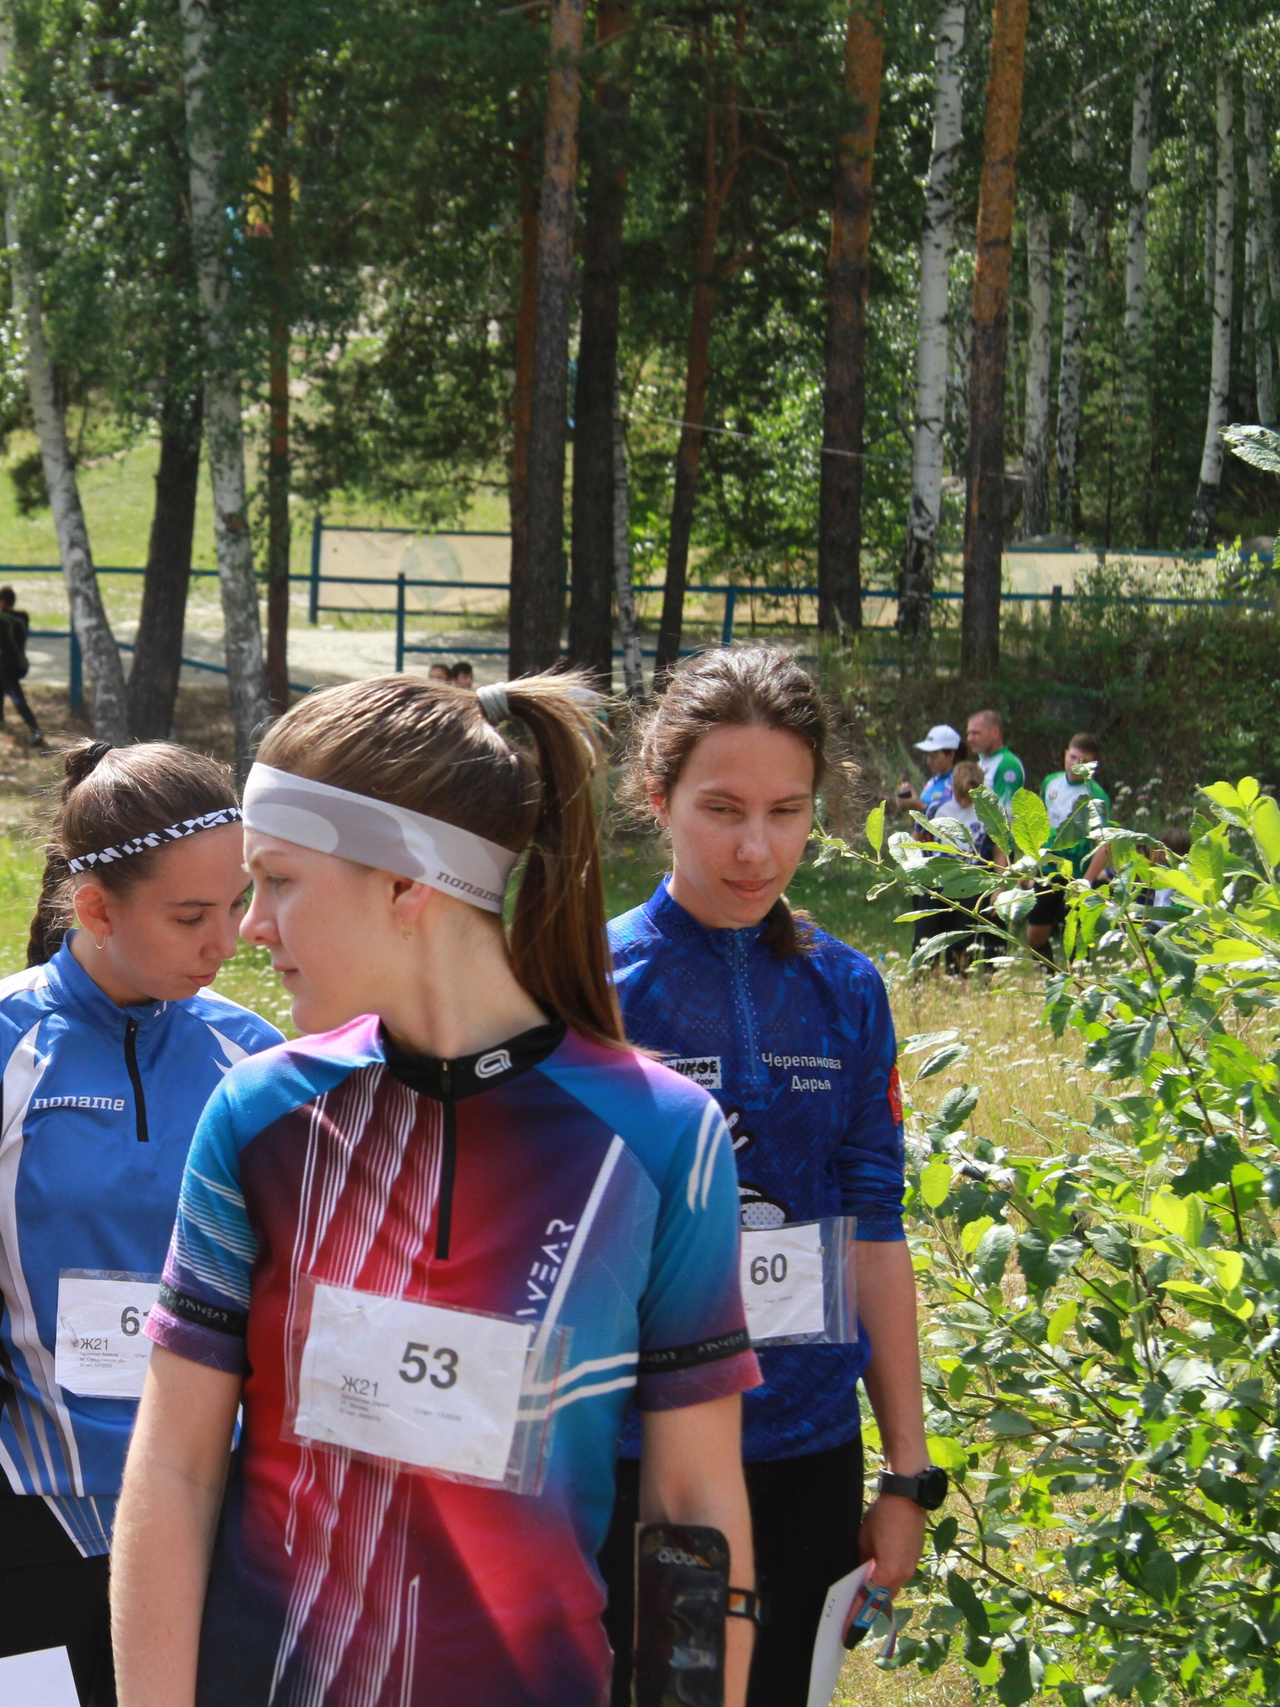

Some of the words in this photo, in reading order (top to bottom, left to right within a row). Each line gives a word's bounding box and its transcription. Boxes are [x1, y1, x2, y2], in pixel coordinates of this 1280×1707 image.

[761, 1052, 842, 1070] Черепанова
[791, 1075, 832, 1092] Дарья
[32, 1096, 125, 1111] noname
[750, 1253, 788, 1286] 60
[80, 1338, 108, 1350] Ж21
[399, 1342, 459, 1389] 53
[341, 1374, 379, 1397] Ж21
